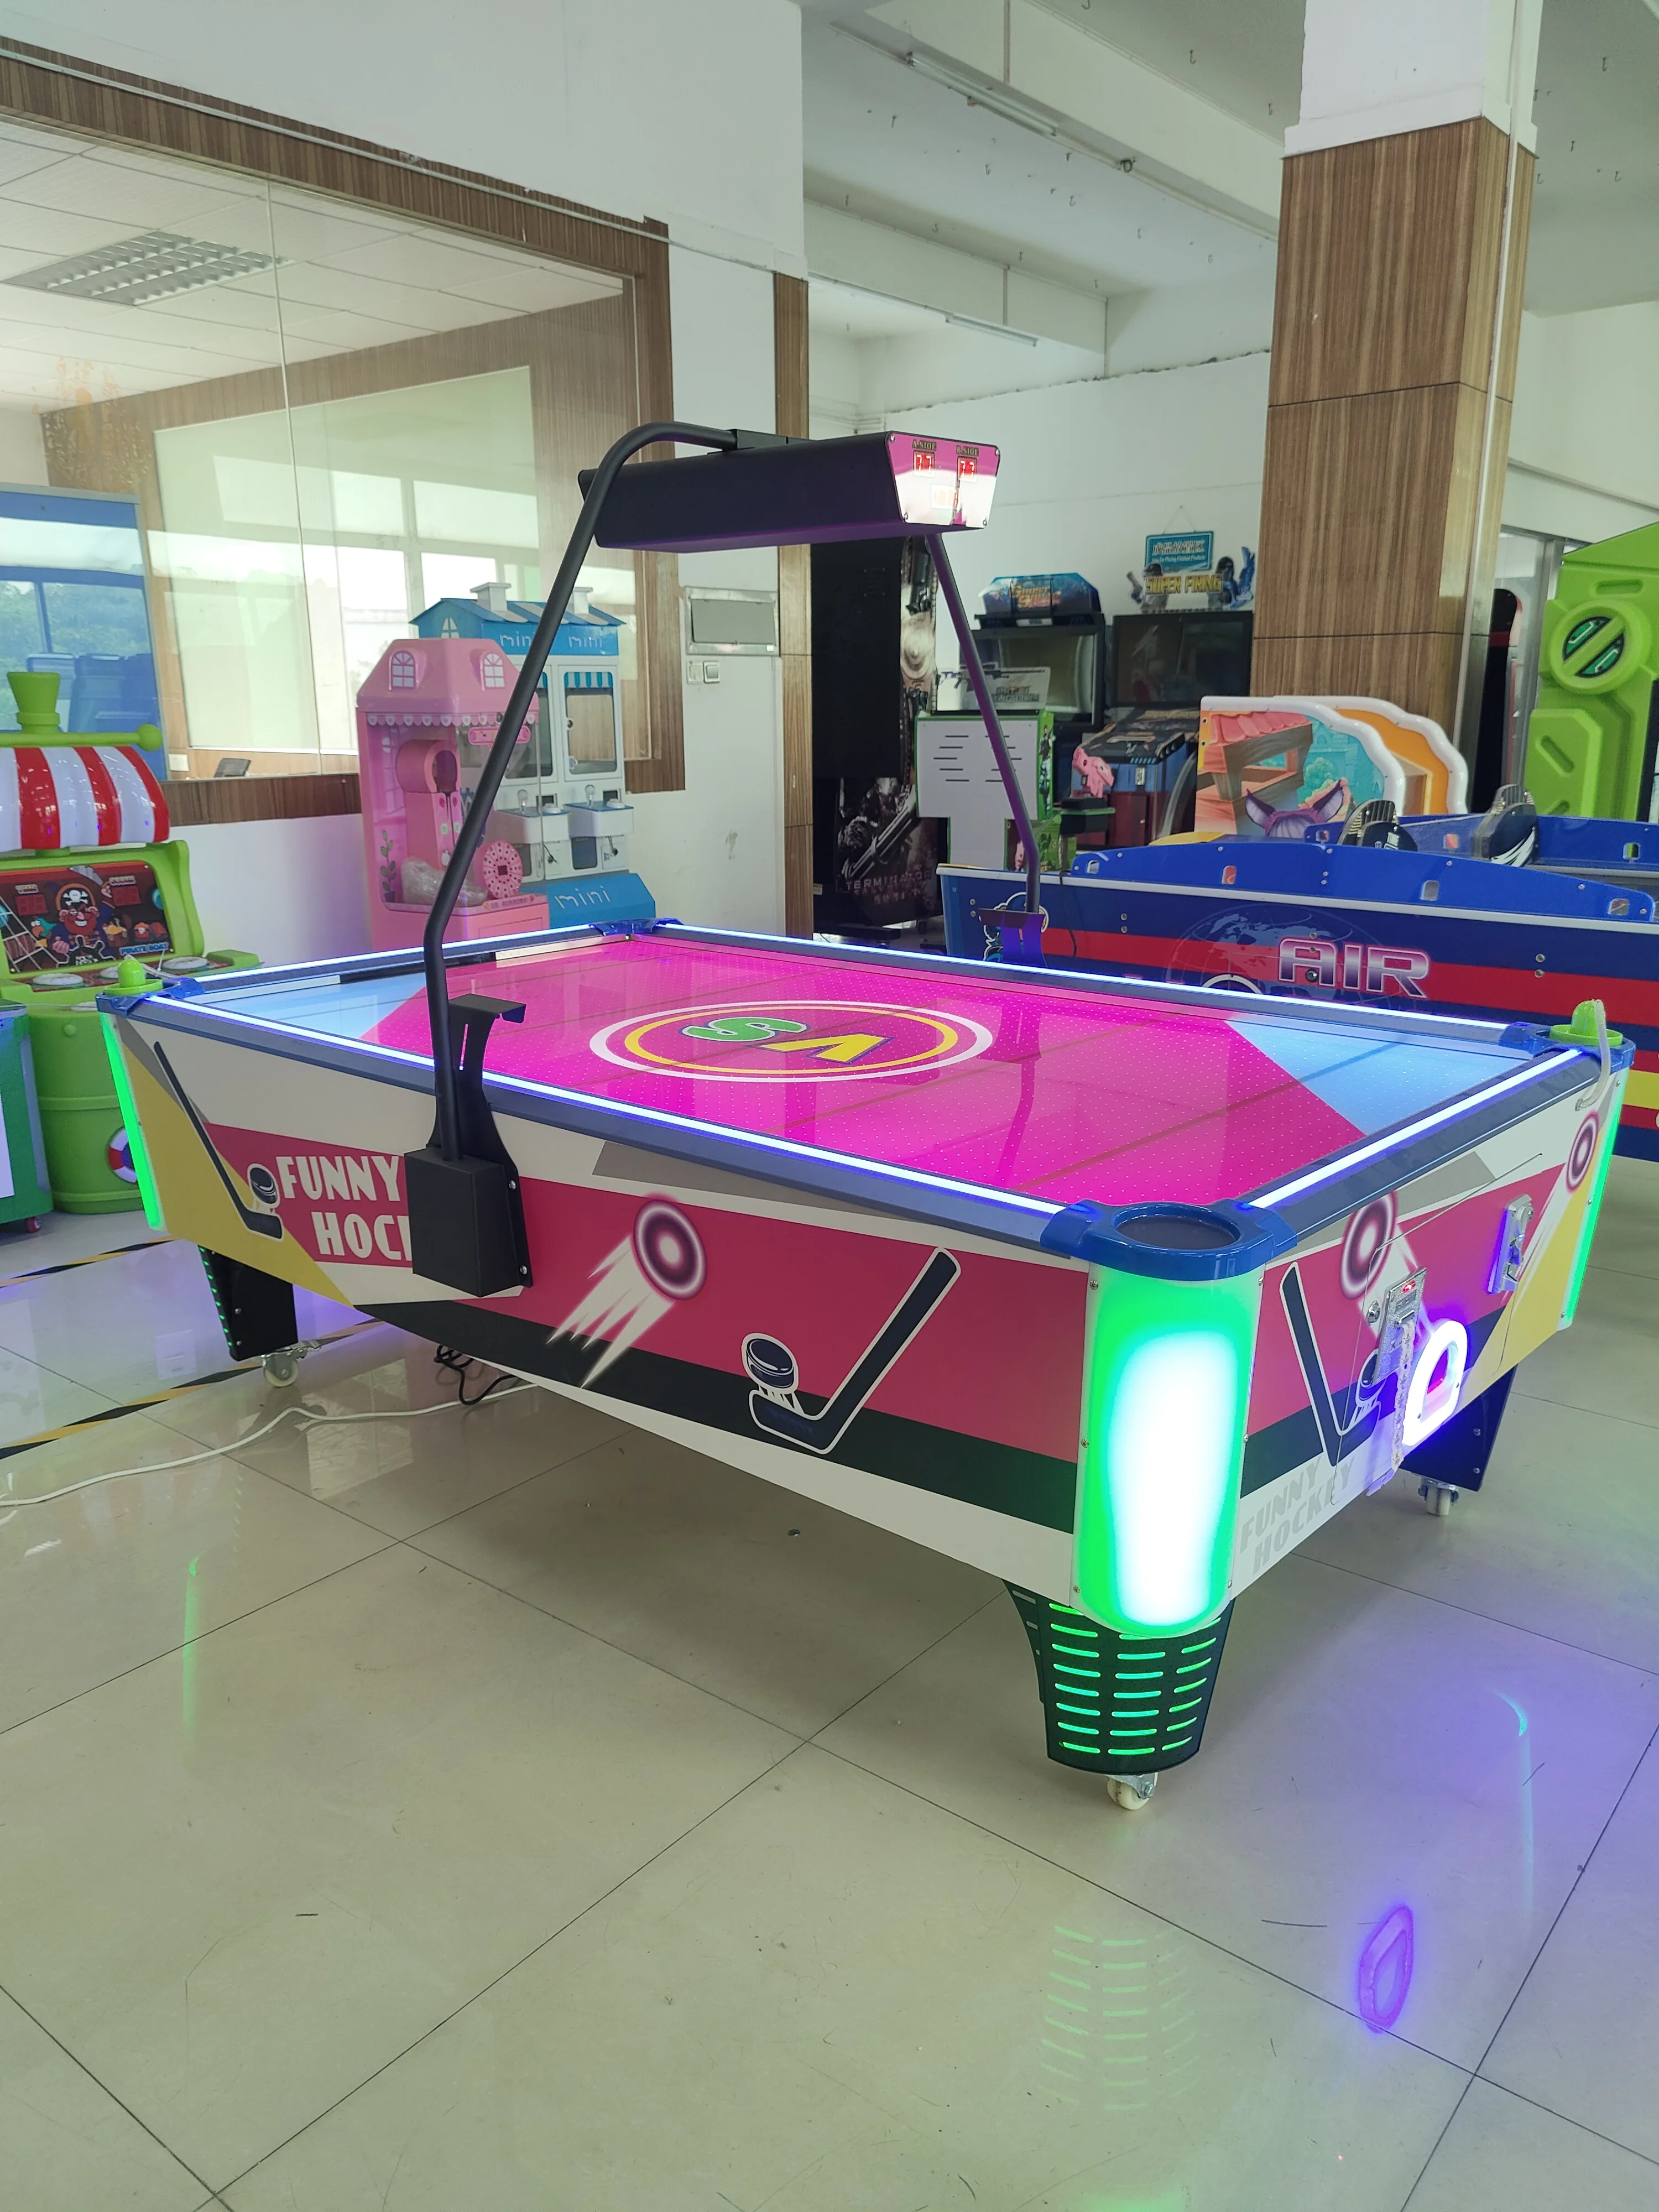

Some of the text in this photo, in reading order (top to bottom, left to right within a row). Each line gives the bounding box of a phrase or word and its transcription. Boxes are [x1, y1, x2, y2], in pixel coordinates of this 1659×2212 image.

[1145, 573, 1222, 594] SUPER FIRING
[499, 631, 535, 648] min
[568, 633, 603, 648] mini
[846, 870, 931, 891] TERMINATOR
[555, 885, 610, 909] mini
[1279, 938, 1430, 998] AIR
[276, 1156, 400, 1201] FUNNY
[1240, 1455, 1322, 1553] FUNNY
[1253, 1456, 1355, 1575] HOCKEY
